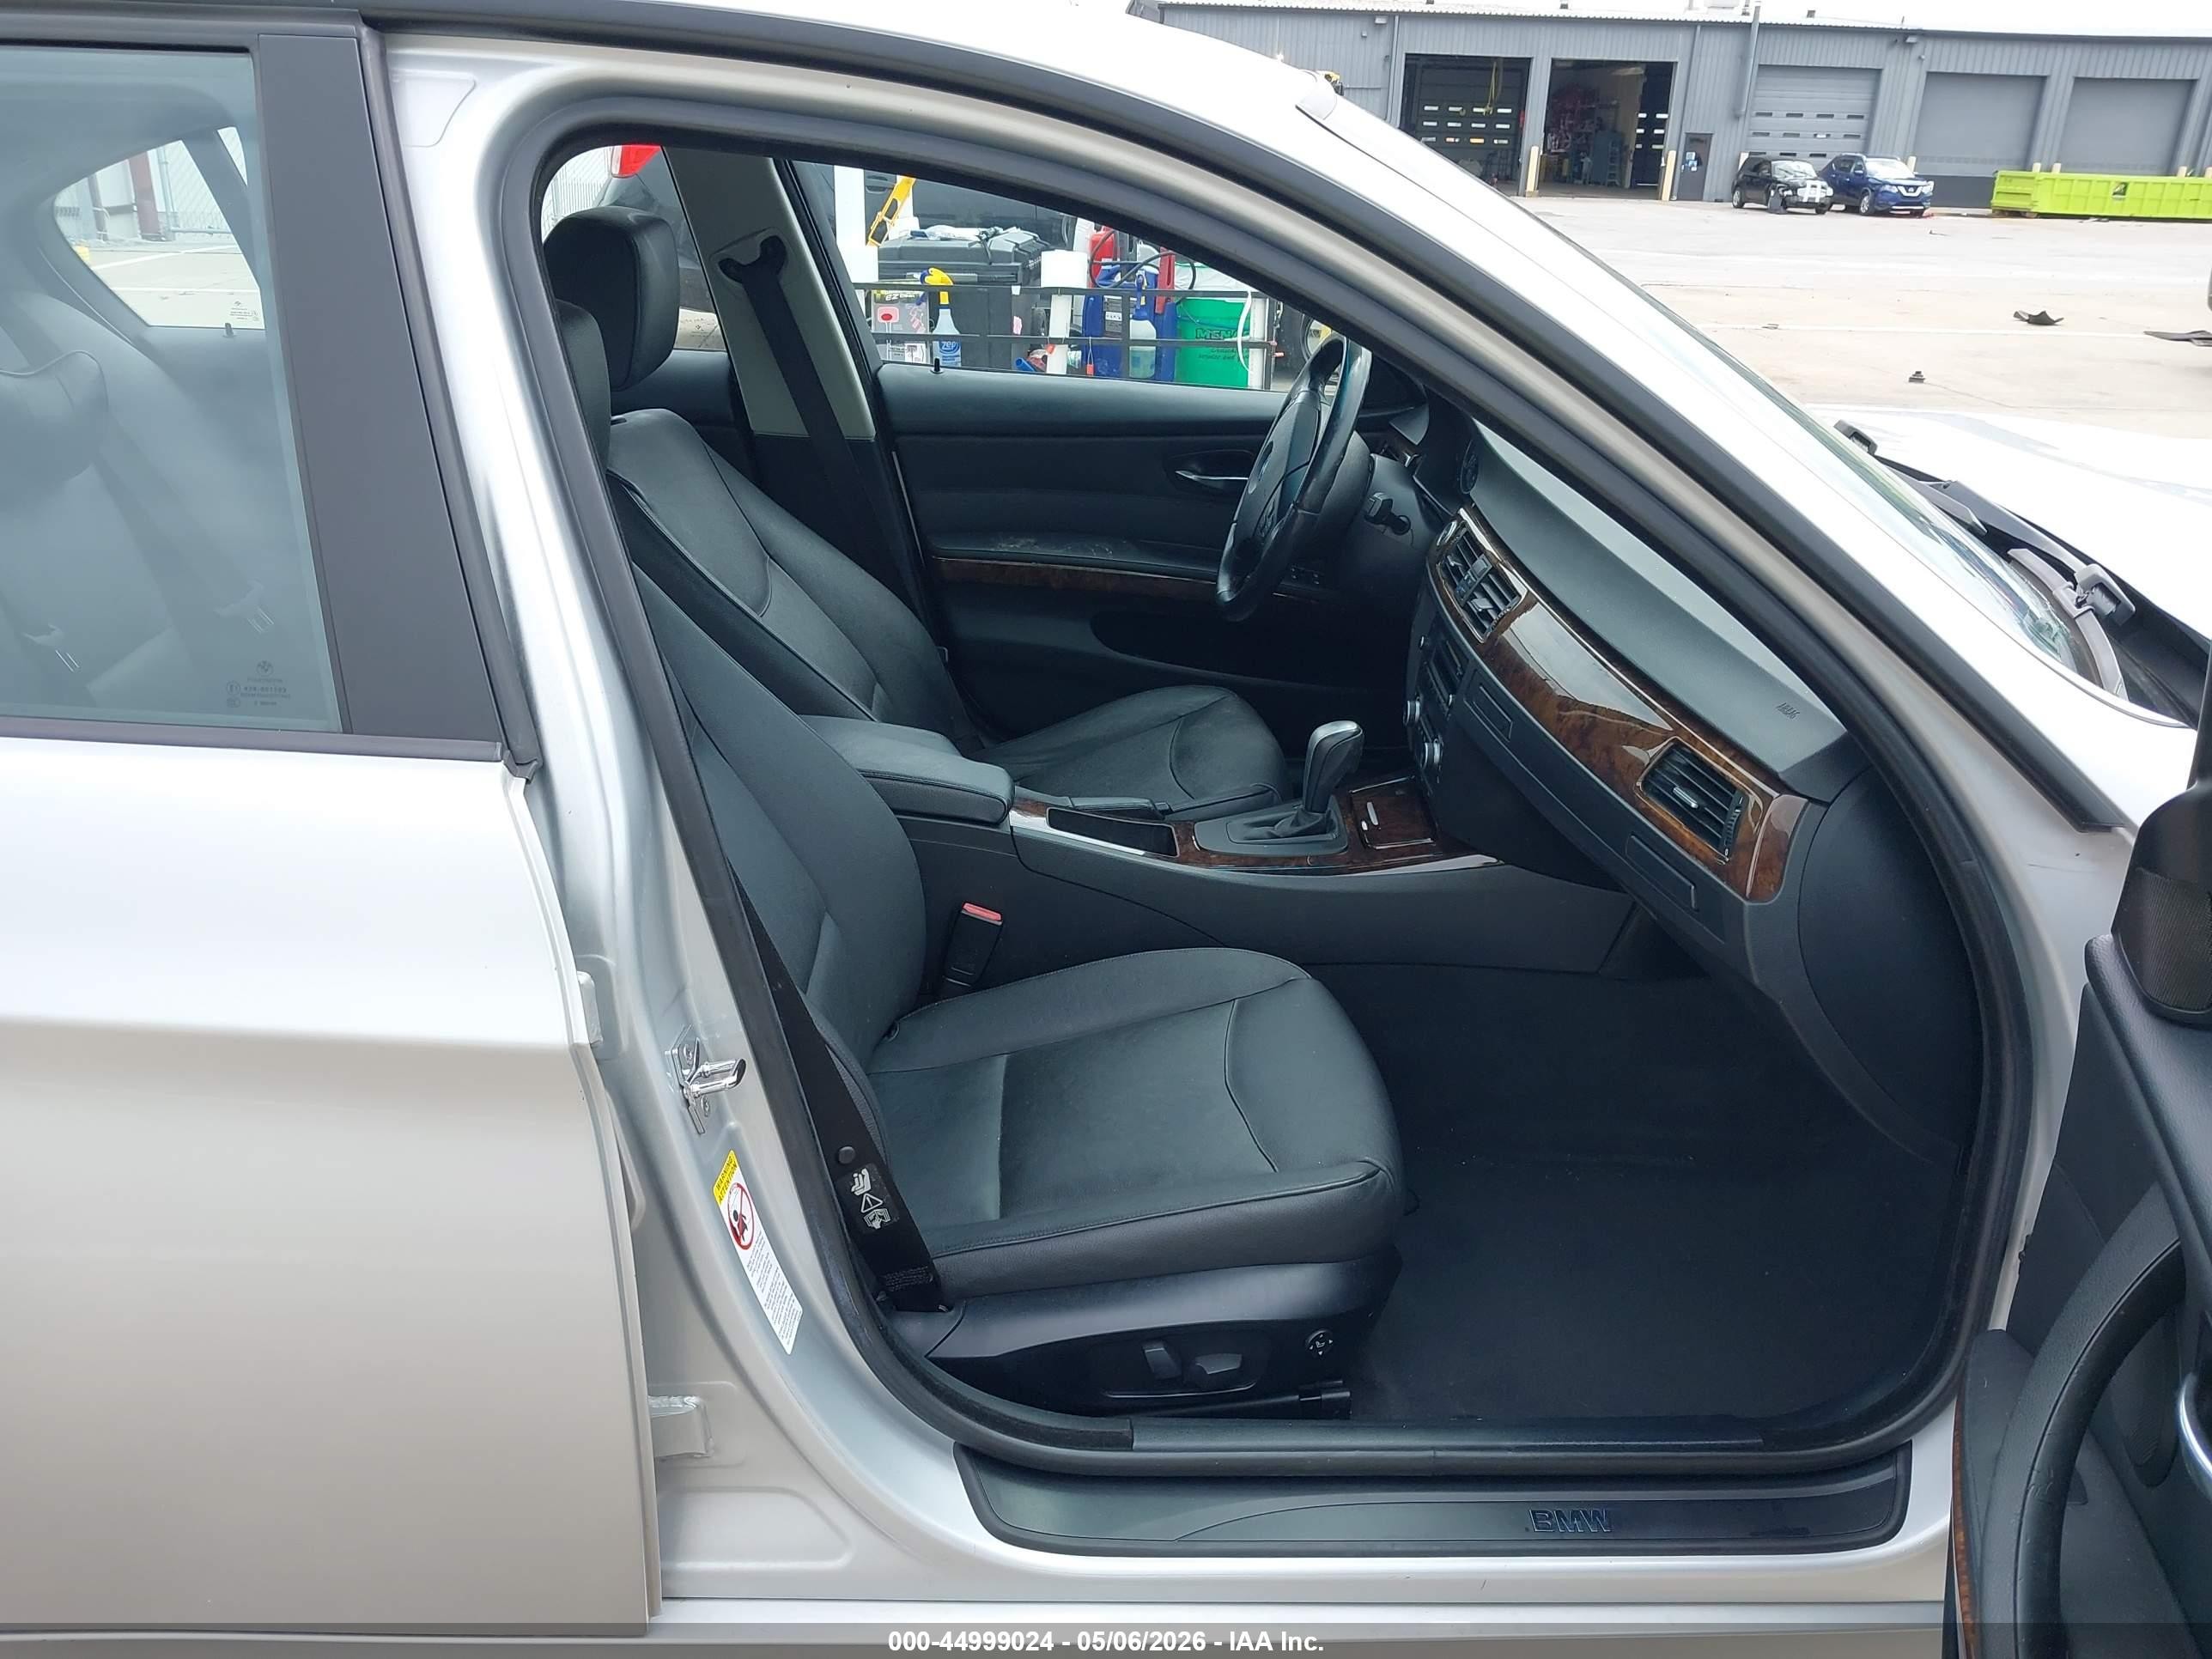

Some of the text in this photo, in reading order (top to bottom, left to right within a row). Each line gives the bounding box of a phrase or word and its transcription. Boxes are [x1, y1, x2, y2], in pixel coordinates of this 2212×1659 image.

[715, 1155, 733, 1191] WARNING
[718, 1160, 738, 1205] ATTENTION
[1529, 1509, 1611, 1533] BMW
